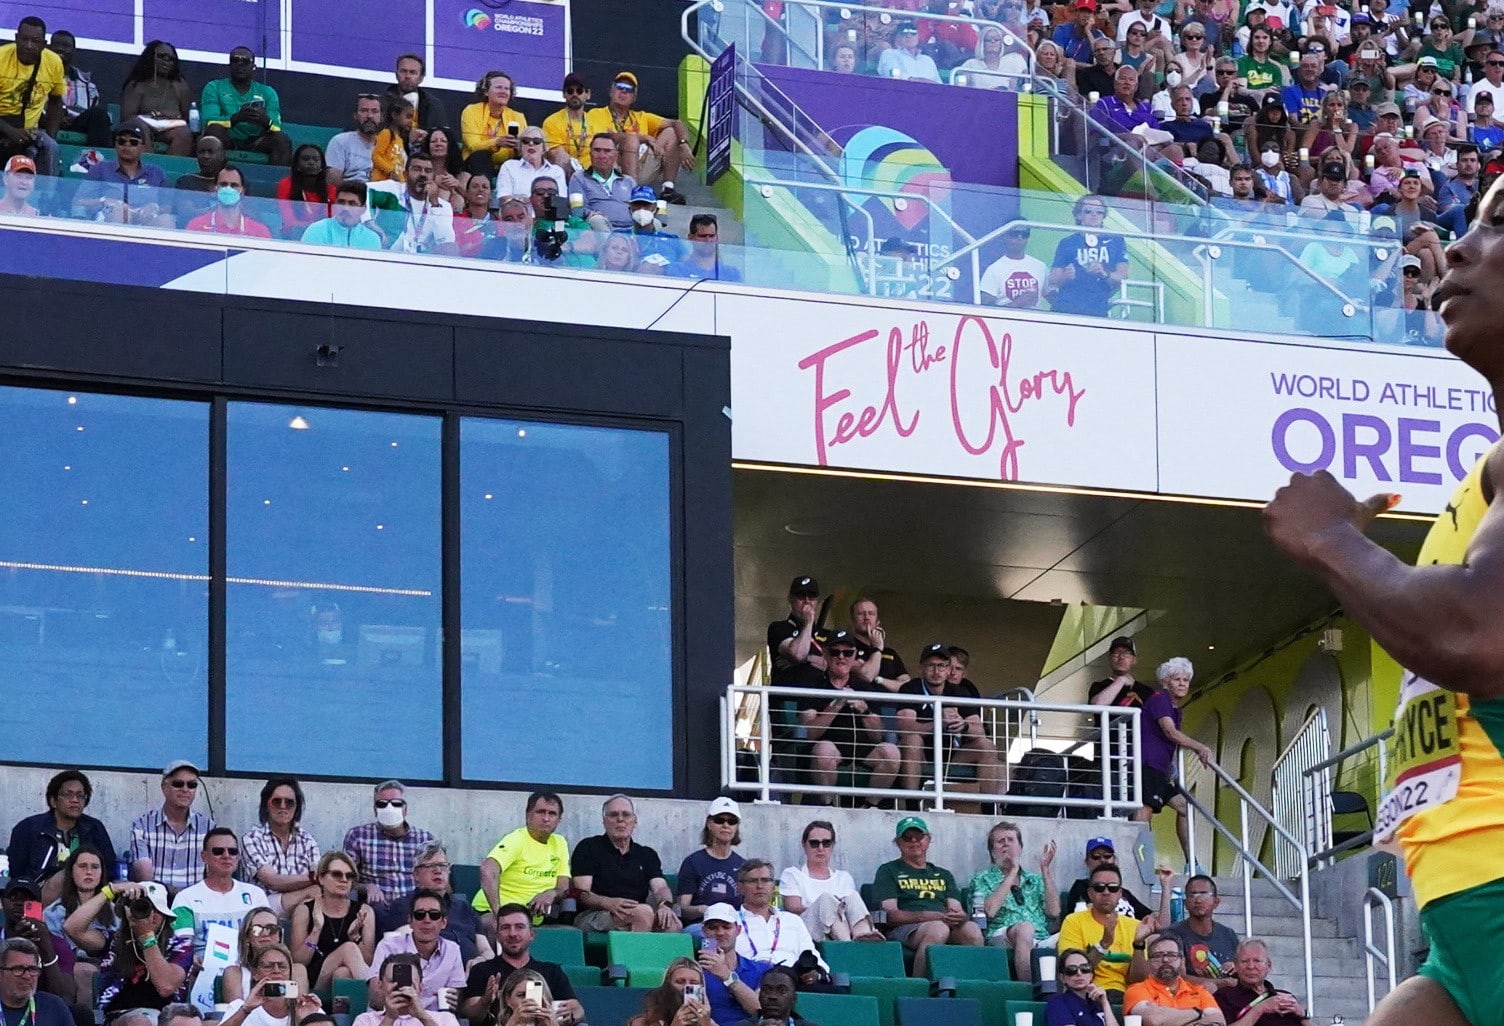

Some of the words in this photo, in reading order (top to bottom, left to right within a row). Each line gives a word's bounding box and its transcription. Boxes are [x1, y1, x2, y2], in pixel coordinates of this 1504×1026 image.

[494, 24, 544, 36] OREGON22
[1077, 245, 1110, 266] USA
[1006, 278, 1037, 290] STOP
[1271, 372, 1370, 402] WORLD
[798, 329, 919, 466] Feel
[904, 320, 946, 374] the
[950, 315, 1086, 481] Glory
